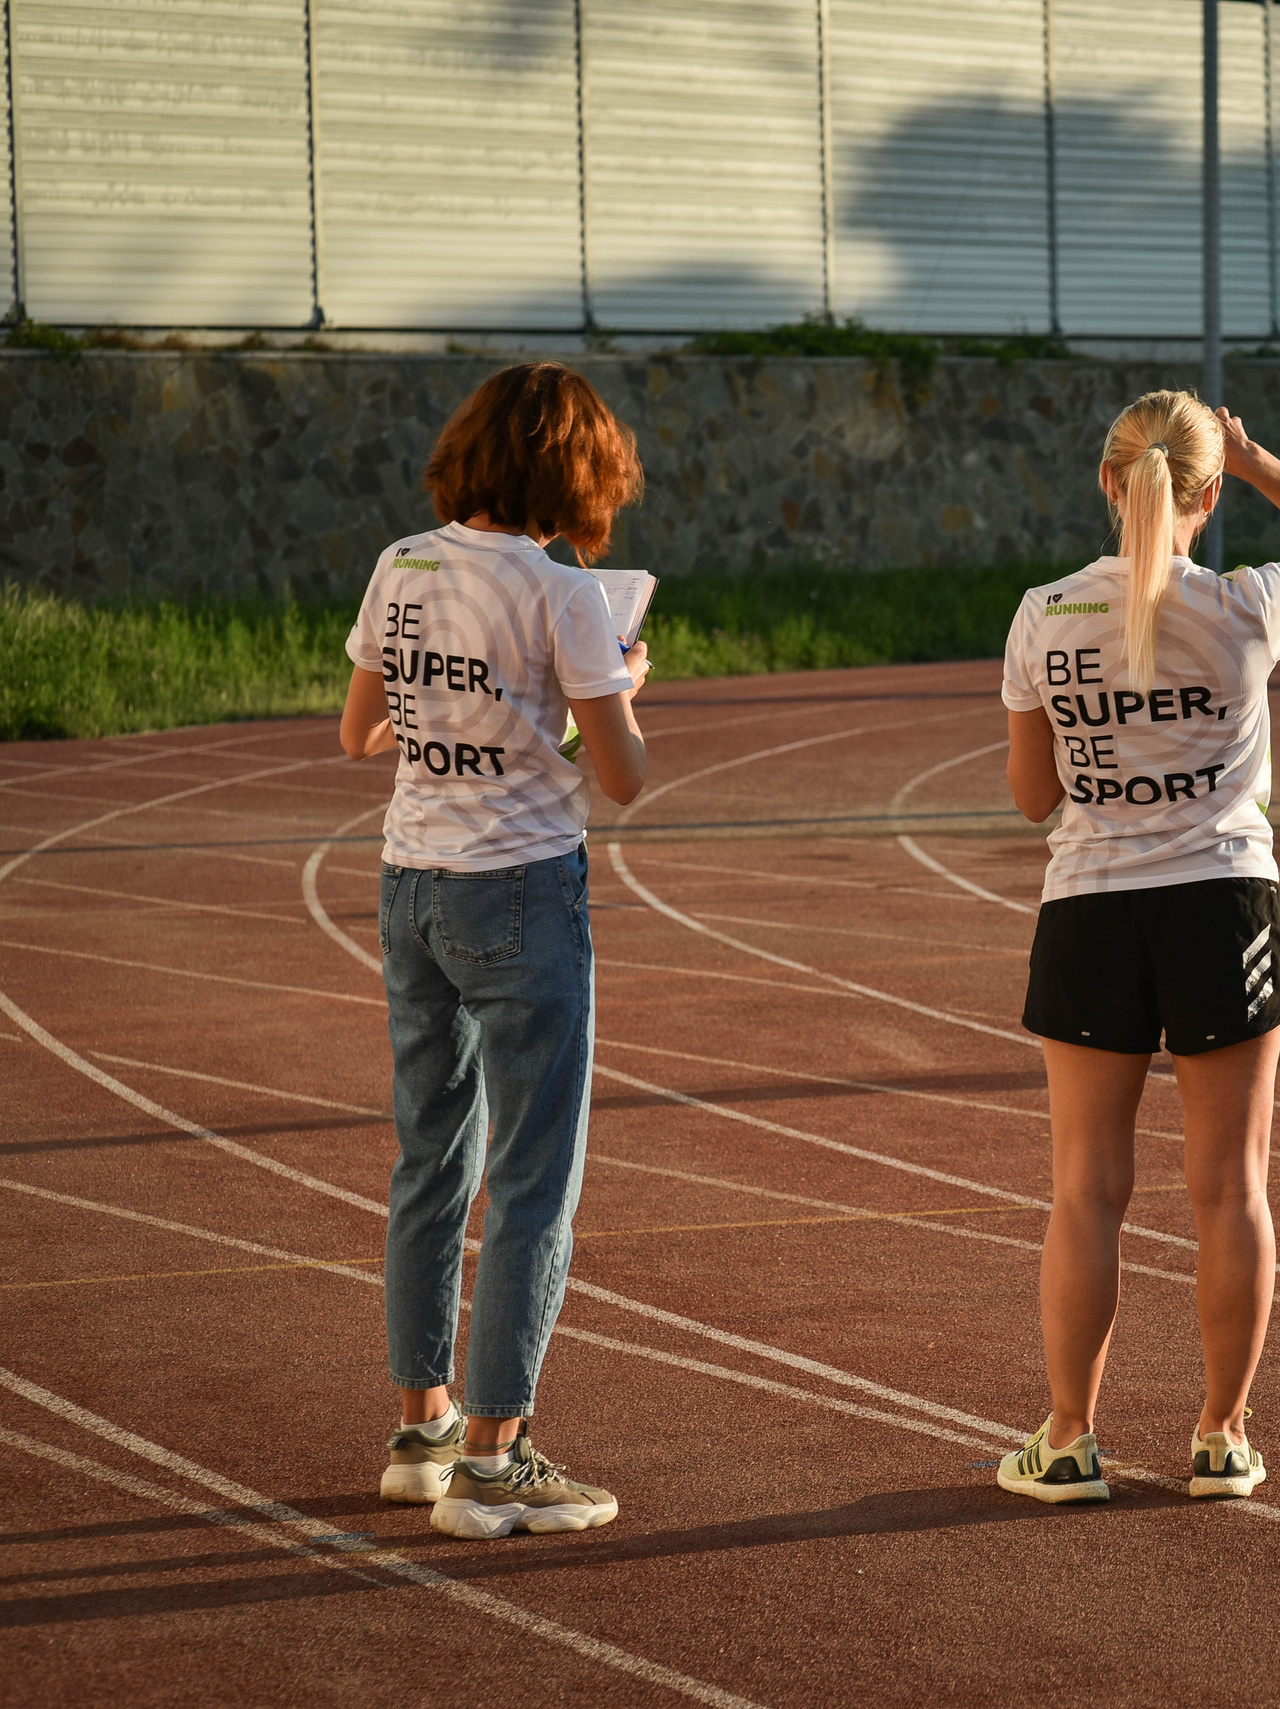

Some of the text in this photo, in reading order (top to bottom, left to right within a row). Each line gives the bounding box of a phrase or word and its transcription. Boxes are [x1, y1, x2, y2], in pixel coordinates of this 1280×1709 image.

[393, 557, 441, 572] RUNNING
[385, 602, 423, 640] BE
[1045, 602, 1109, 617] RUNNING
[382, 646, 503, 701] SUPER,
[1046, 648, 1103, 686] BE
[386, 690, 419, 730] BE
[1051, 686, 1228, 729] SUPER,
[1064, 734, 1118, 769] BE
[1069, 763, 1225, 806] SPORT
